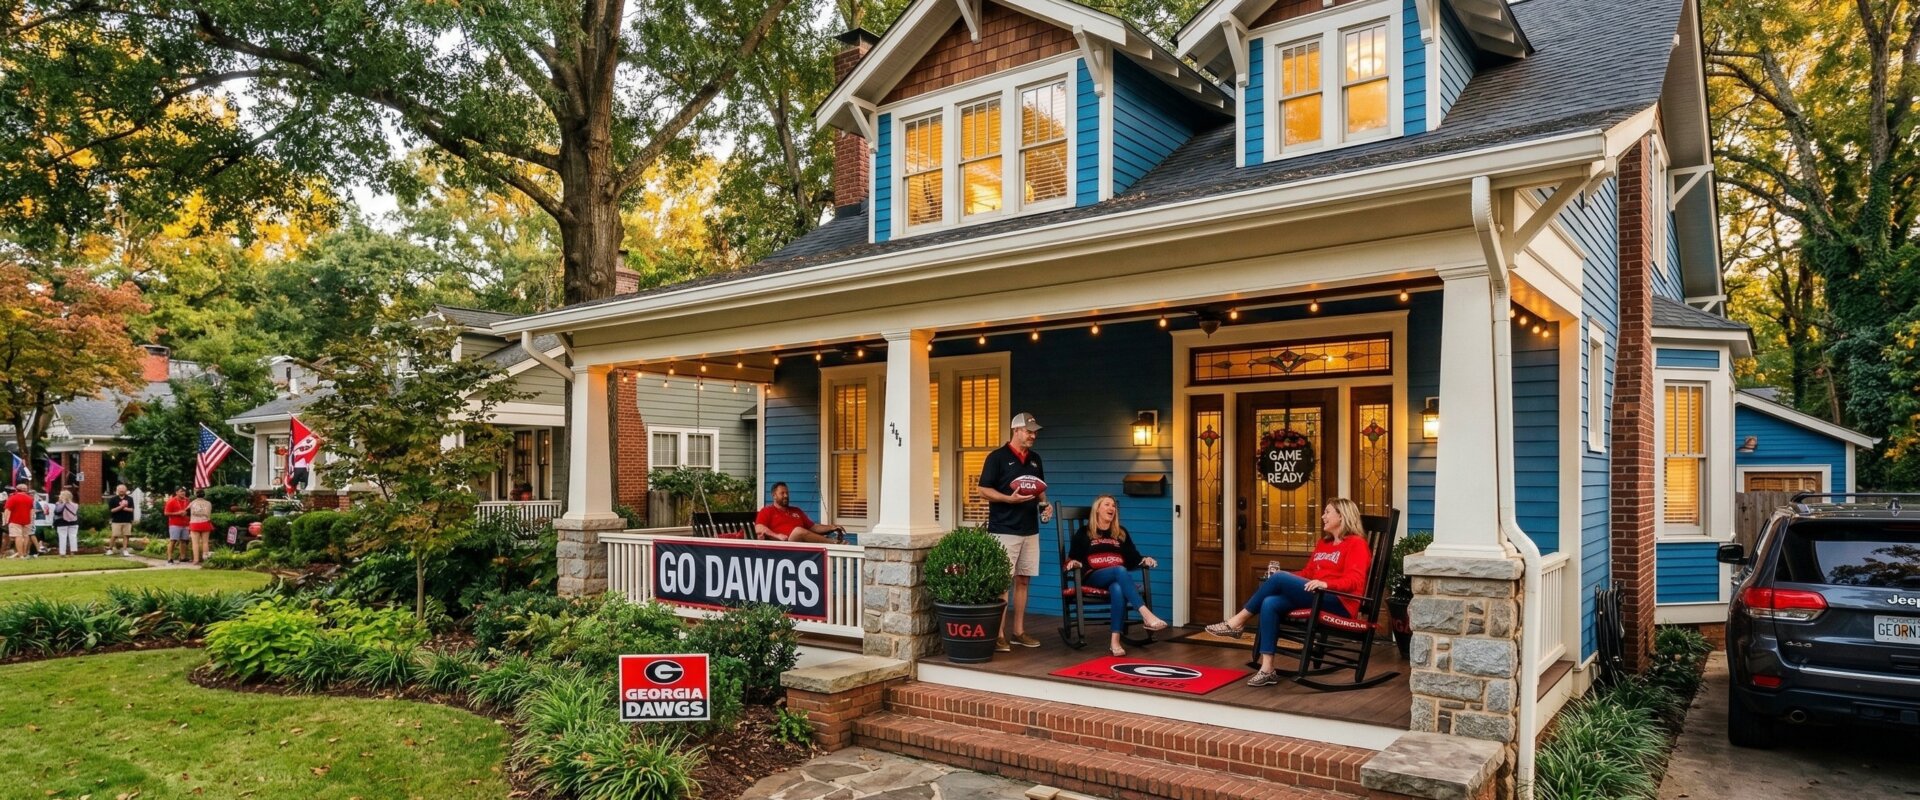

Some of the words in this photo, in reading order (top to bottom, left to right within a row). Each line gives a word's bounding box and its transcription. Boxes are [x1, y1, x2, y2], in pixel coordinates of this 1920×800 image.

[1269, 450, 1302, 461] GAME
[1275, 461, 1297, 472] DAY
[1268, 472, 1304, 483] READY
[659, 551, 696, 596] GO
[705, 554, 820, 608] DAWGS
[946, 622, 986, 638] UGA
[1878, 622, 1920, 638] GEORN
[625, 687, 704, 701] GEORGIA
[625, 701, 704, 717] DAWGS
